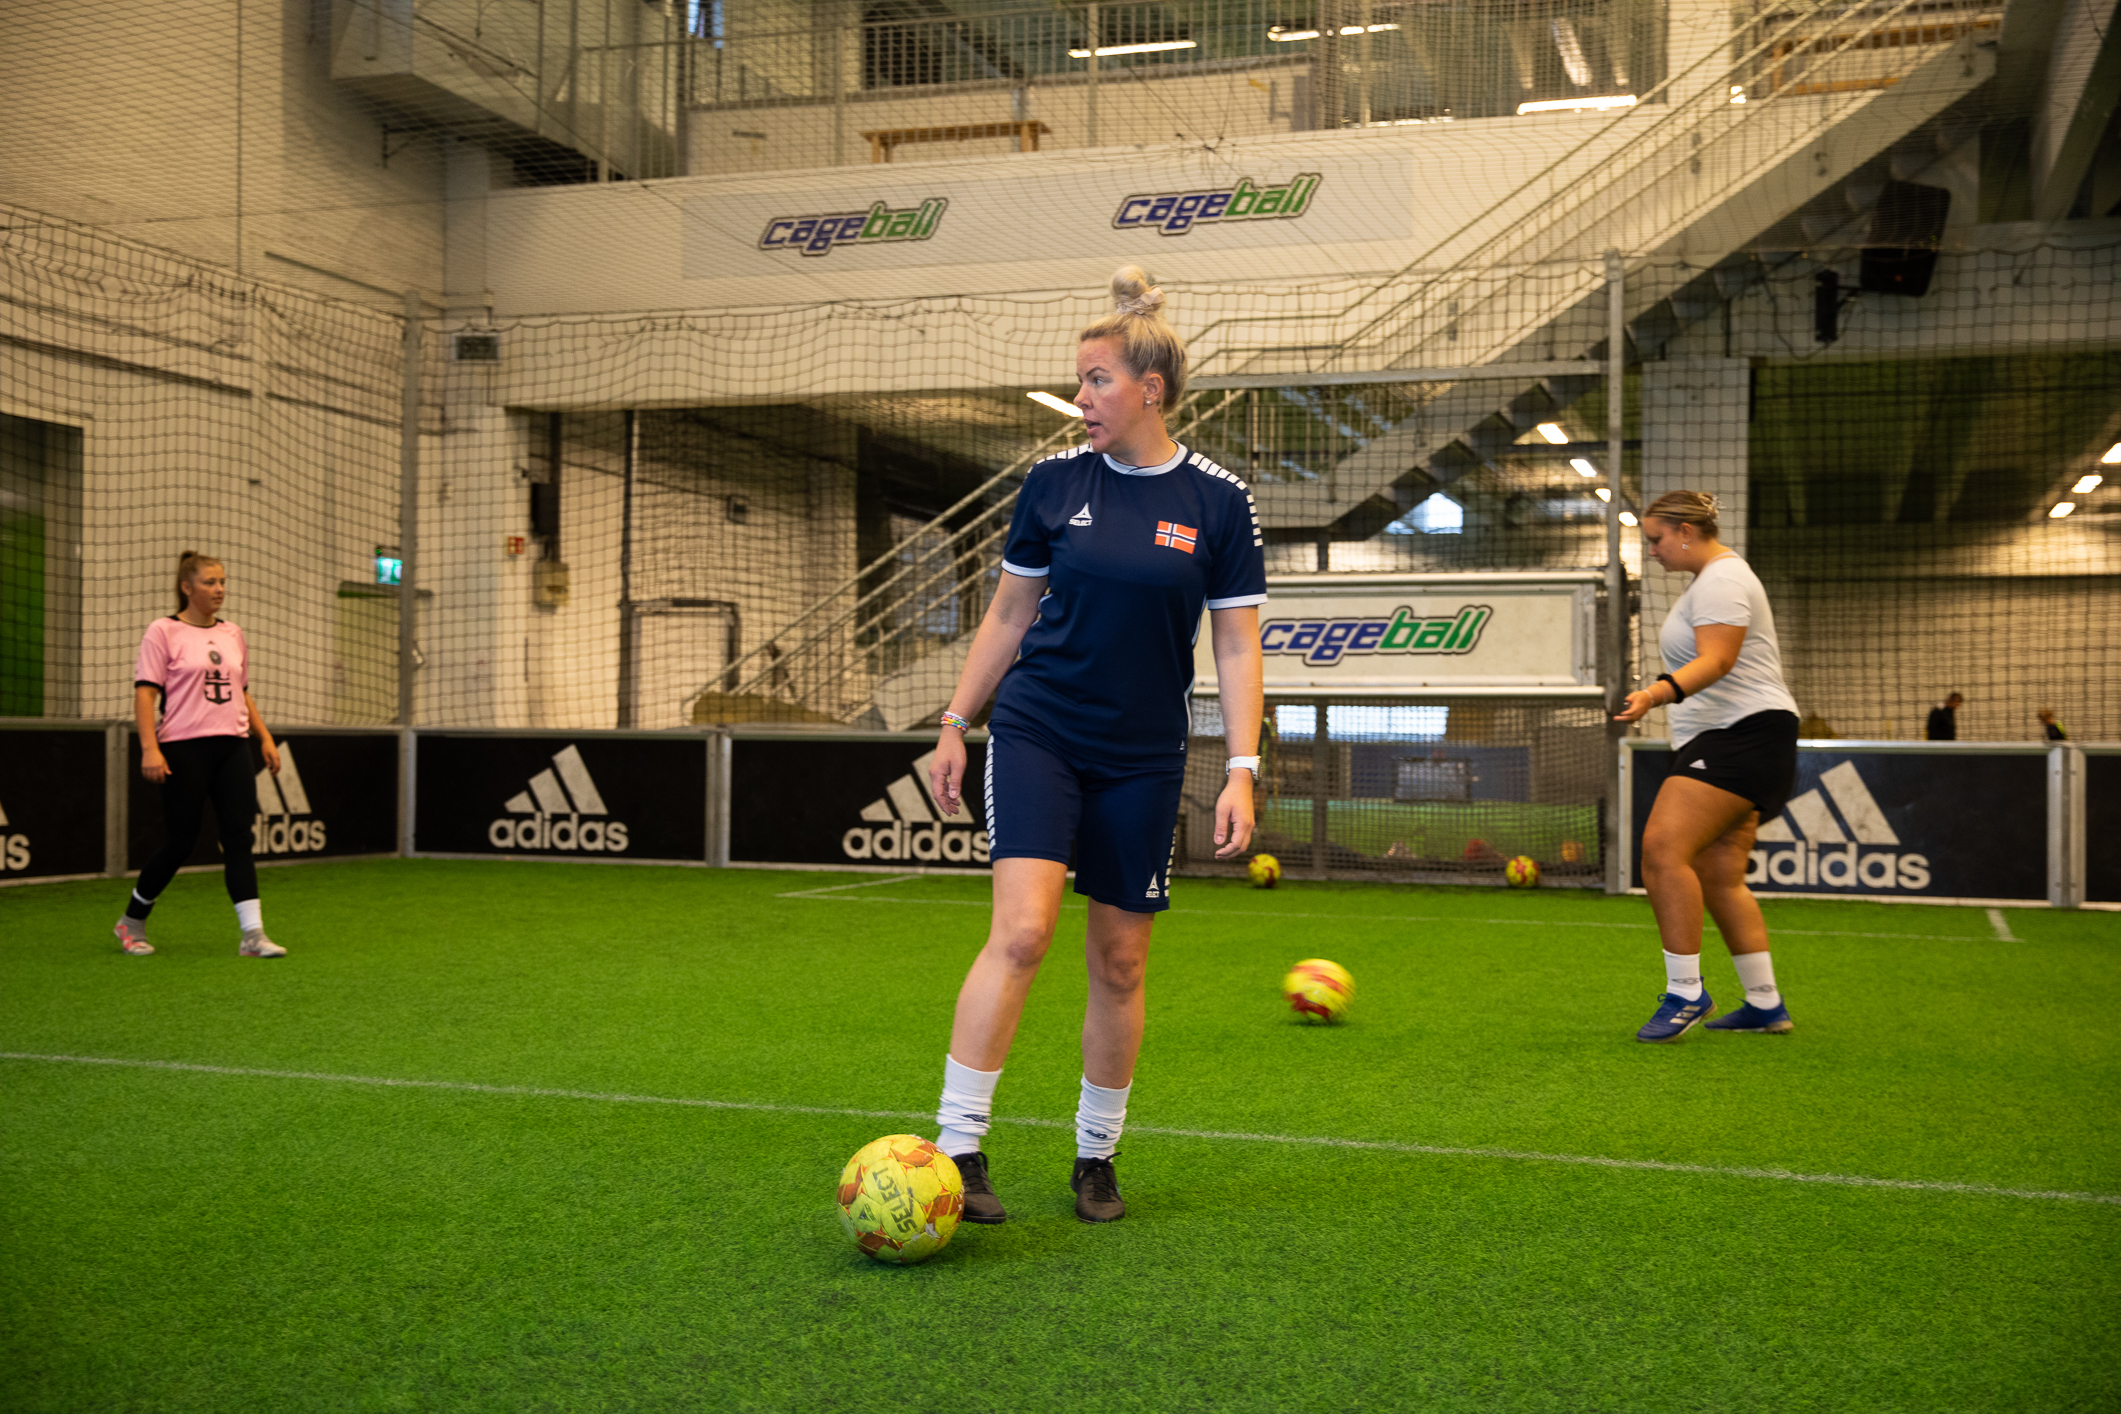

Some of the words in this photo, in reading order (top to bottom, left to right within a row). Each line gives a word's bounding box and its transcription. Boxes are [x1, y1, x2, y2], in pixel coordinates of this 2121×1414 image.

[762, 201, 943, 252] cageball
[1116, 177, 1316, 231] cageball
[1261, 609, 1487, 661] cageball
[218, 812, 327, 855] didas
[488, 811, 630, 852] adidas
[841, 818, 991, 863] adidas
[872, 1167, 918, 1234] SELECT
